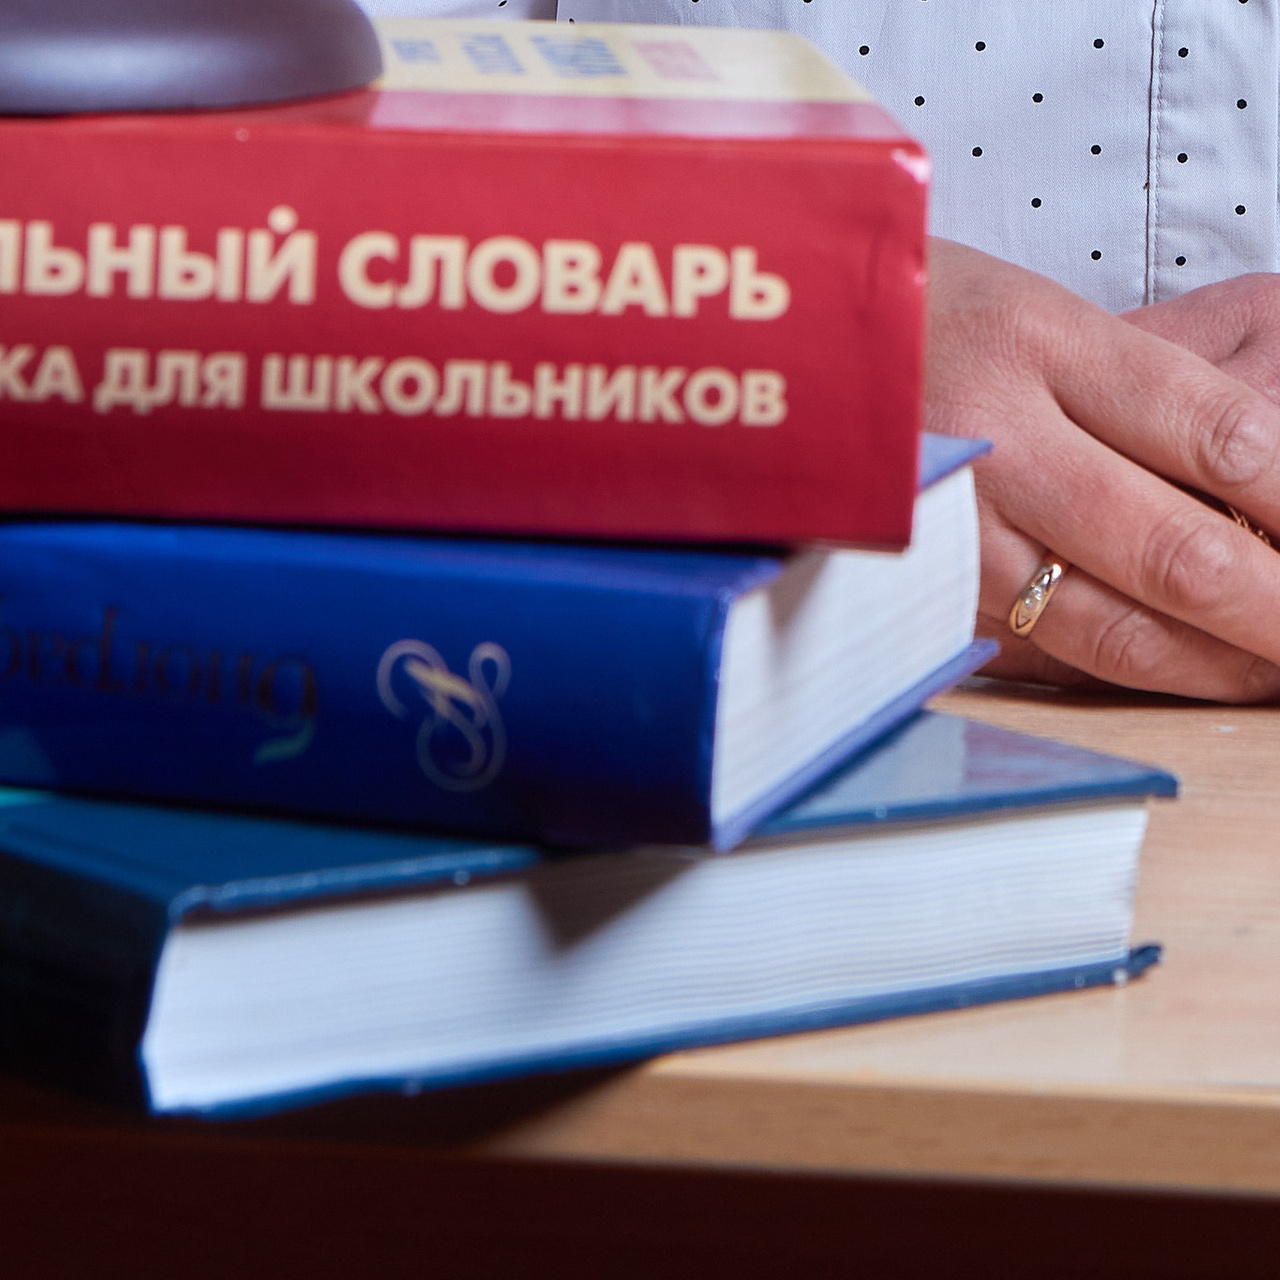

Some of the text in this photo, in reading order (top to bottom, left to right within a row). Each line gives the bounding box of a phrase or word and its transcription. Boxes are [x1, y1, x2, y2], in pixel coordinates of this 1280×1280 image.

[0, 204, 792, 321] ЬНЫЙ СЛОВАРЬ
[92, 346, 249, 417] ДЛЯ
[259, 351, 790, 428] ШКОЛЬНИКОВ
